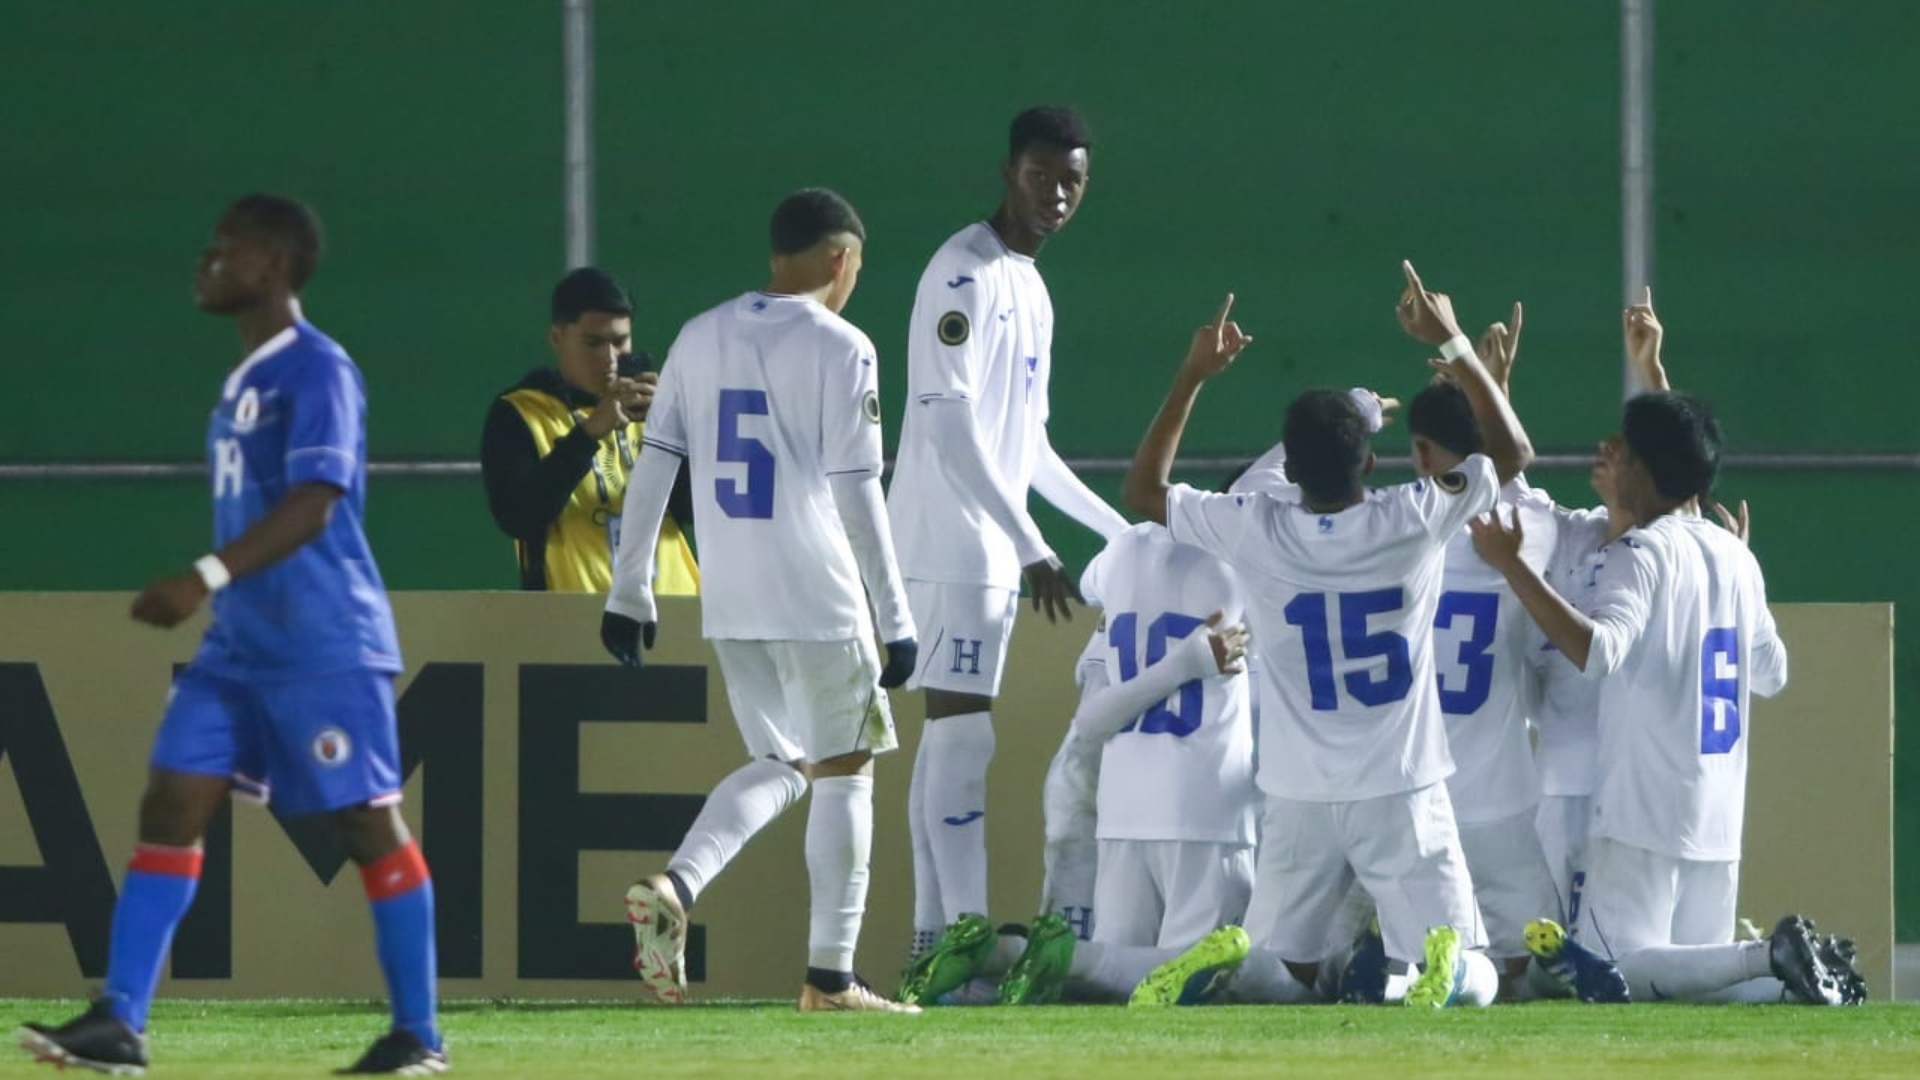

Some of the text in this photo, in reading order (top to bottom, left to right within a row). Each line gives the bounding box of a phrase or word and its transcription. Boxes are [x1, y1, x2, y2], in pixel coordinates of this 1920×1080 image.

[715, 389, 775, 519] 5
[951, 637, 982, 674] H
[1284, 586, 1413, 711] 15
[1700, 627, 1740, 754] 6
